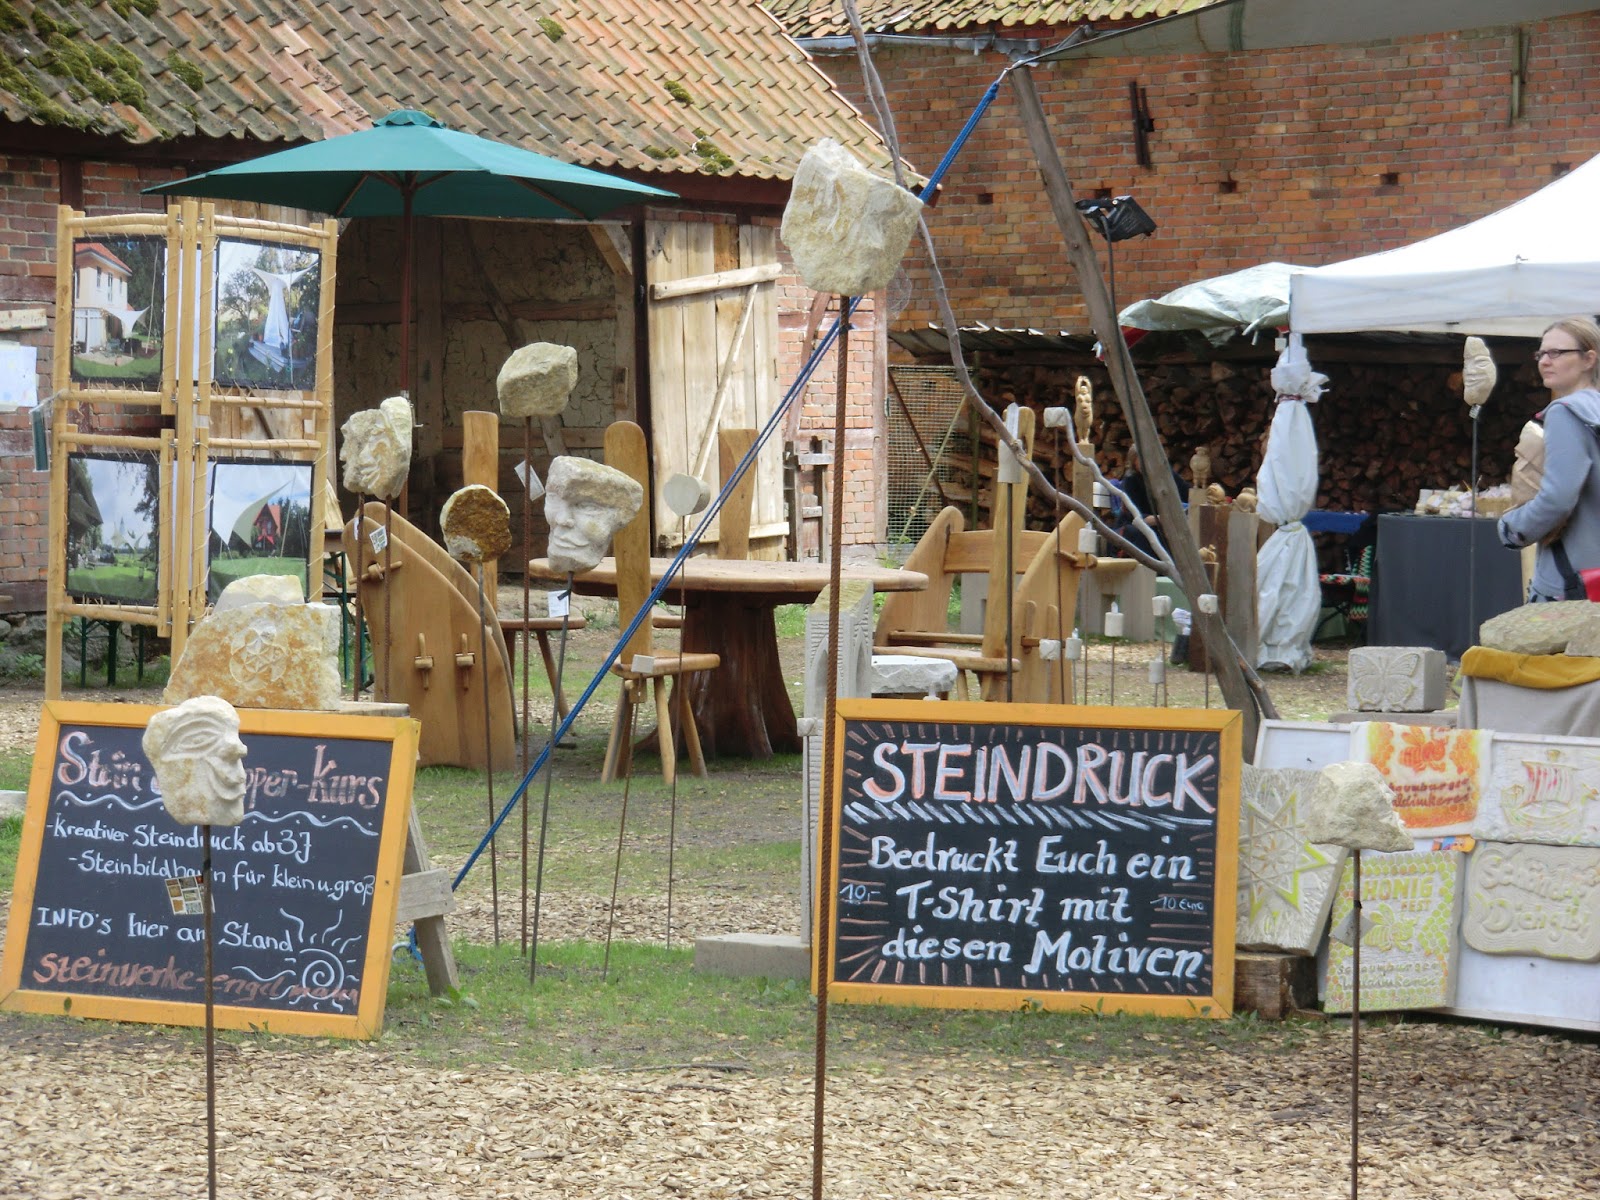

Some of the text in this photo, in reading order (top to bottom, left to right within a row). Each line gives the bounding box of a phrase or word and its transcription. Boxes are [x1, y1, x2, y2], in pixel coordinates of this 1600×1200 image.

[862, 742, 1216, 813] STEINDRUCK
[232, 860, 266, 891] für
[867, 832, 1197, 881] Bedruckt Euch ein
[896, 881, 1134, 927] T-Shirt mit
[1362, 877, 1433, 900] HONIG
[1401, 898, 1431, 912] FEST
[37, 907, 112, 935] INFO's
[128, 912, 169, 938] hier
[218, 920, 293, 952] Stand
[882, 925, 1204, 979] diesen Motiven
